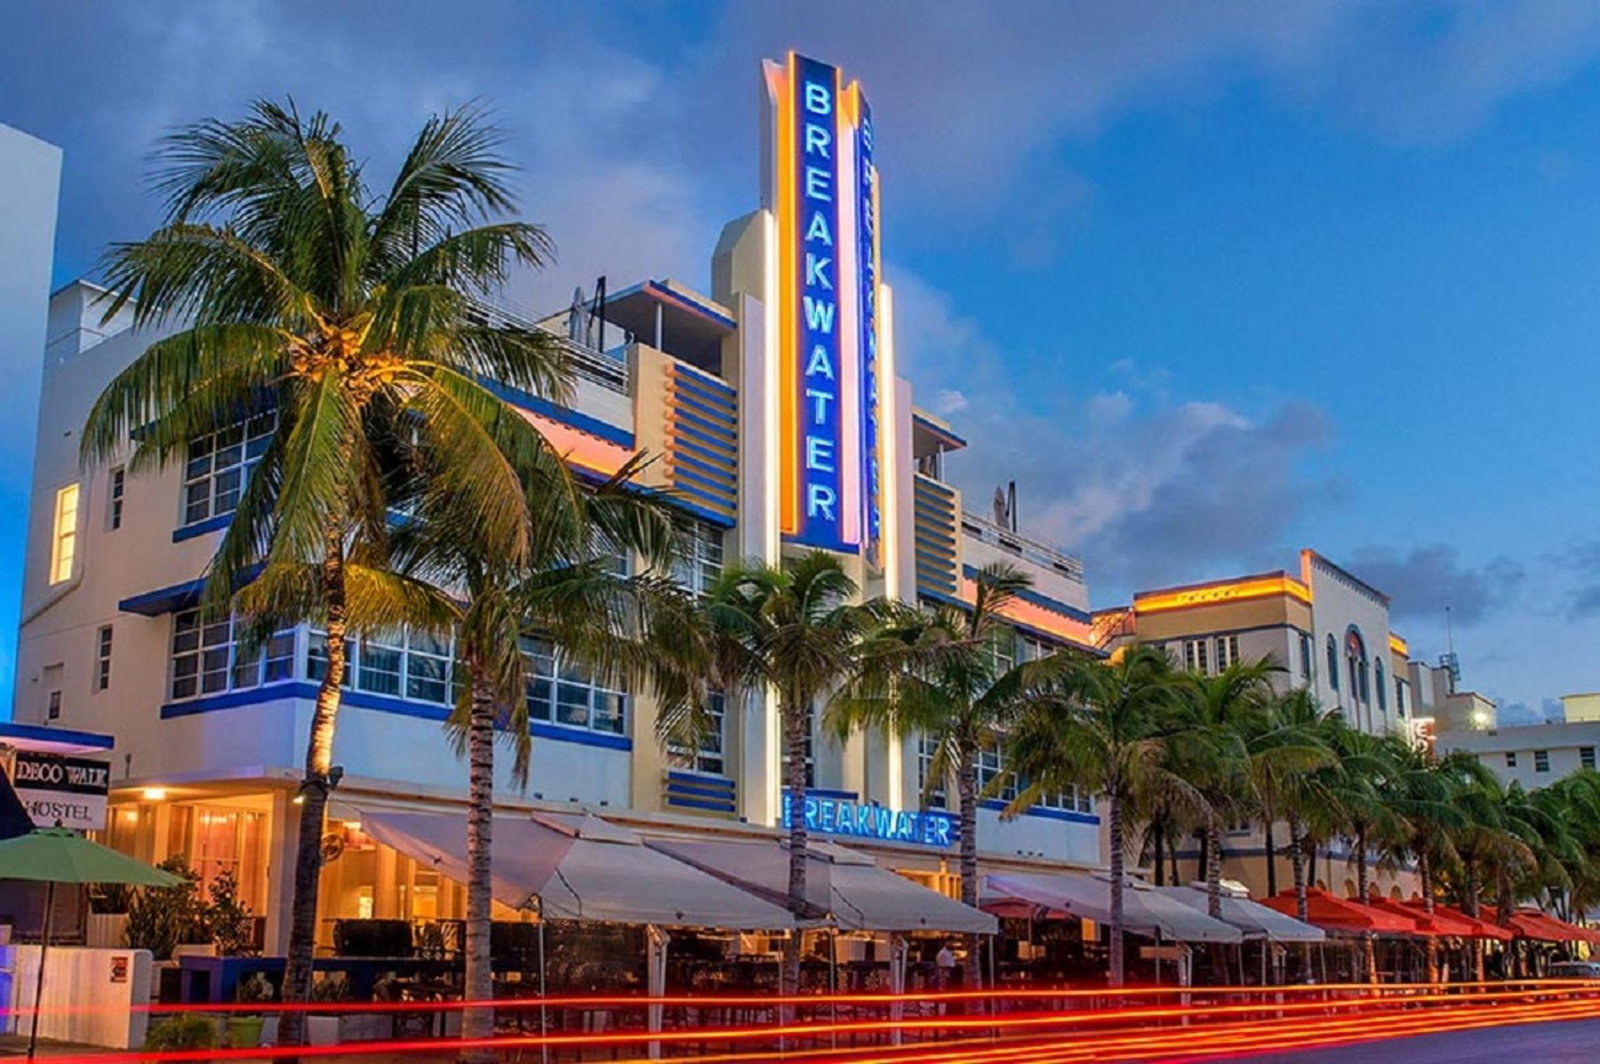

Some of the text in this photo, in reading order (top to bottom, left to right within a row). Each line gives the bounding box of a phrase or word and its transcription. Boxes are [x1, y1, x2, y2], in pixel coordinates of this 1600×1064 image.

[803, 80, 837, 521] BREAKWATER
[16, 761, 107, 788] DECO WALK
[26, 800, 92, 821] HOSTEL
